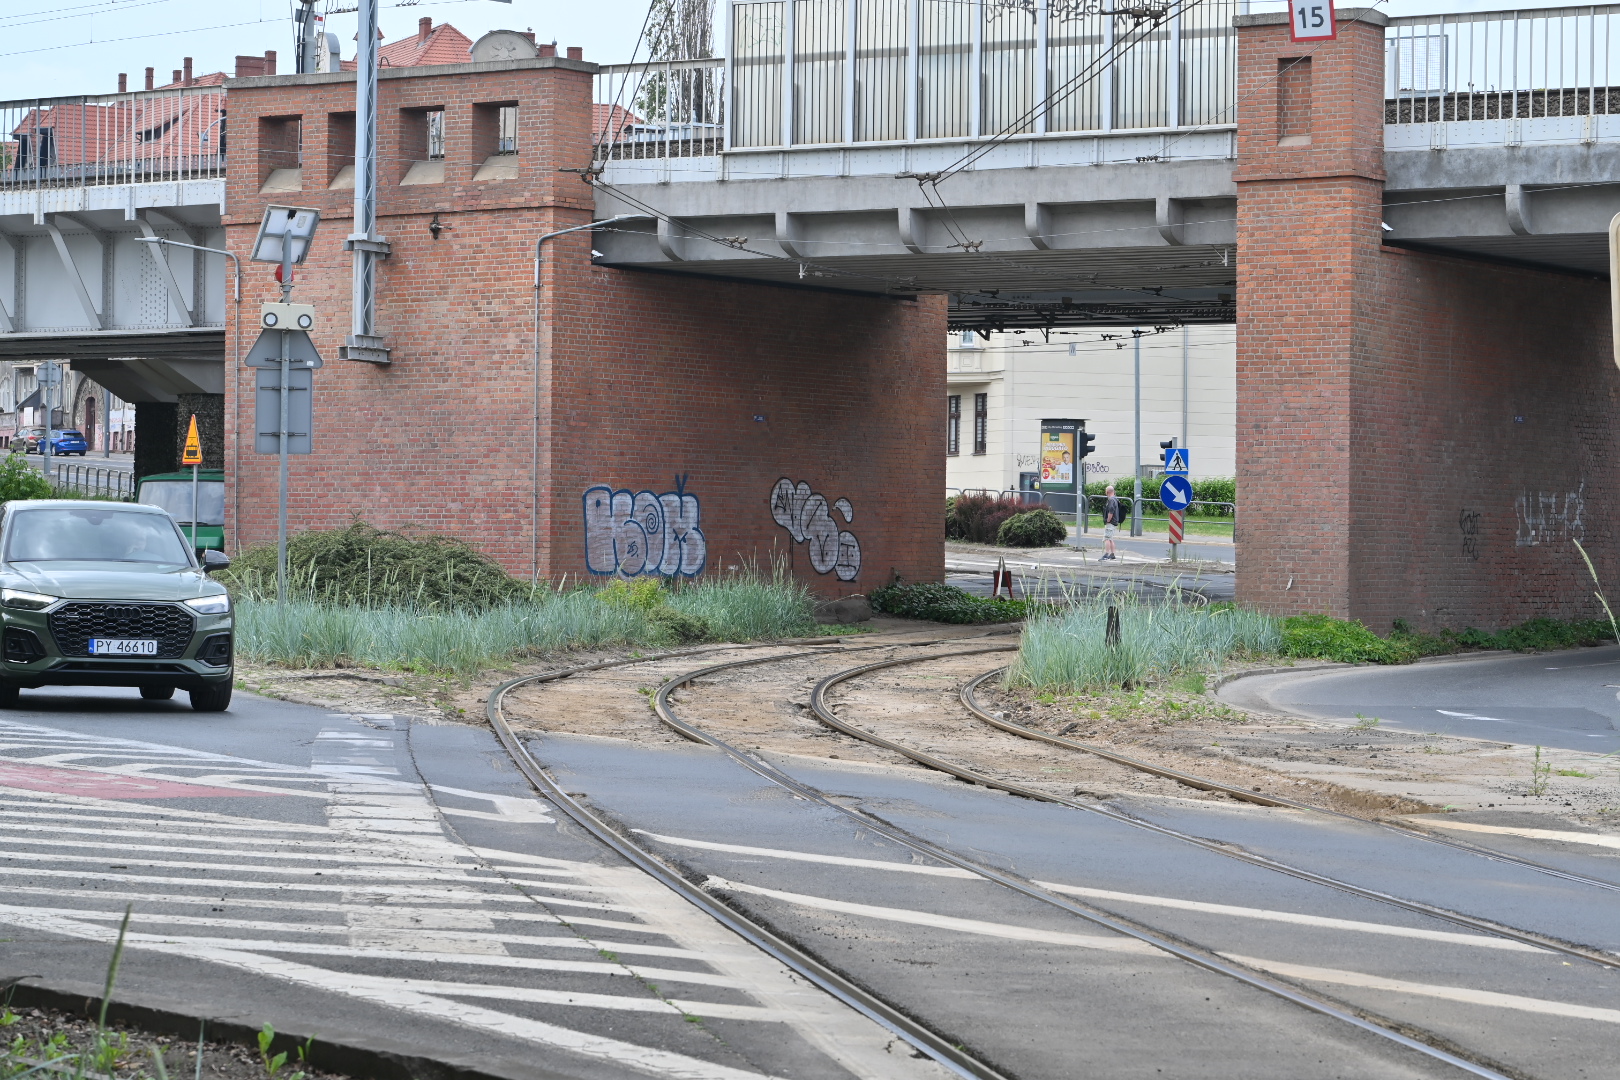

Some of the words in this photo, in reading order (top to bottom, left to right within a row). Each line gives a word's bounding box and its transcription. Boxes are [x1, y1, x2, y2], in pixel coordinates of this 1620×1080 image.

[1298, 6, 1324, 28] 15
[96, 640, 112, 653] PY
[117, 640, 154, 653] 46610
